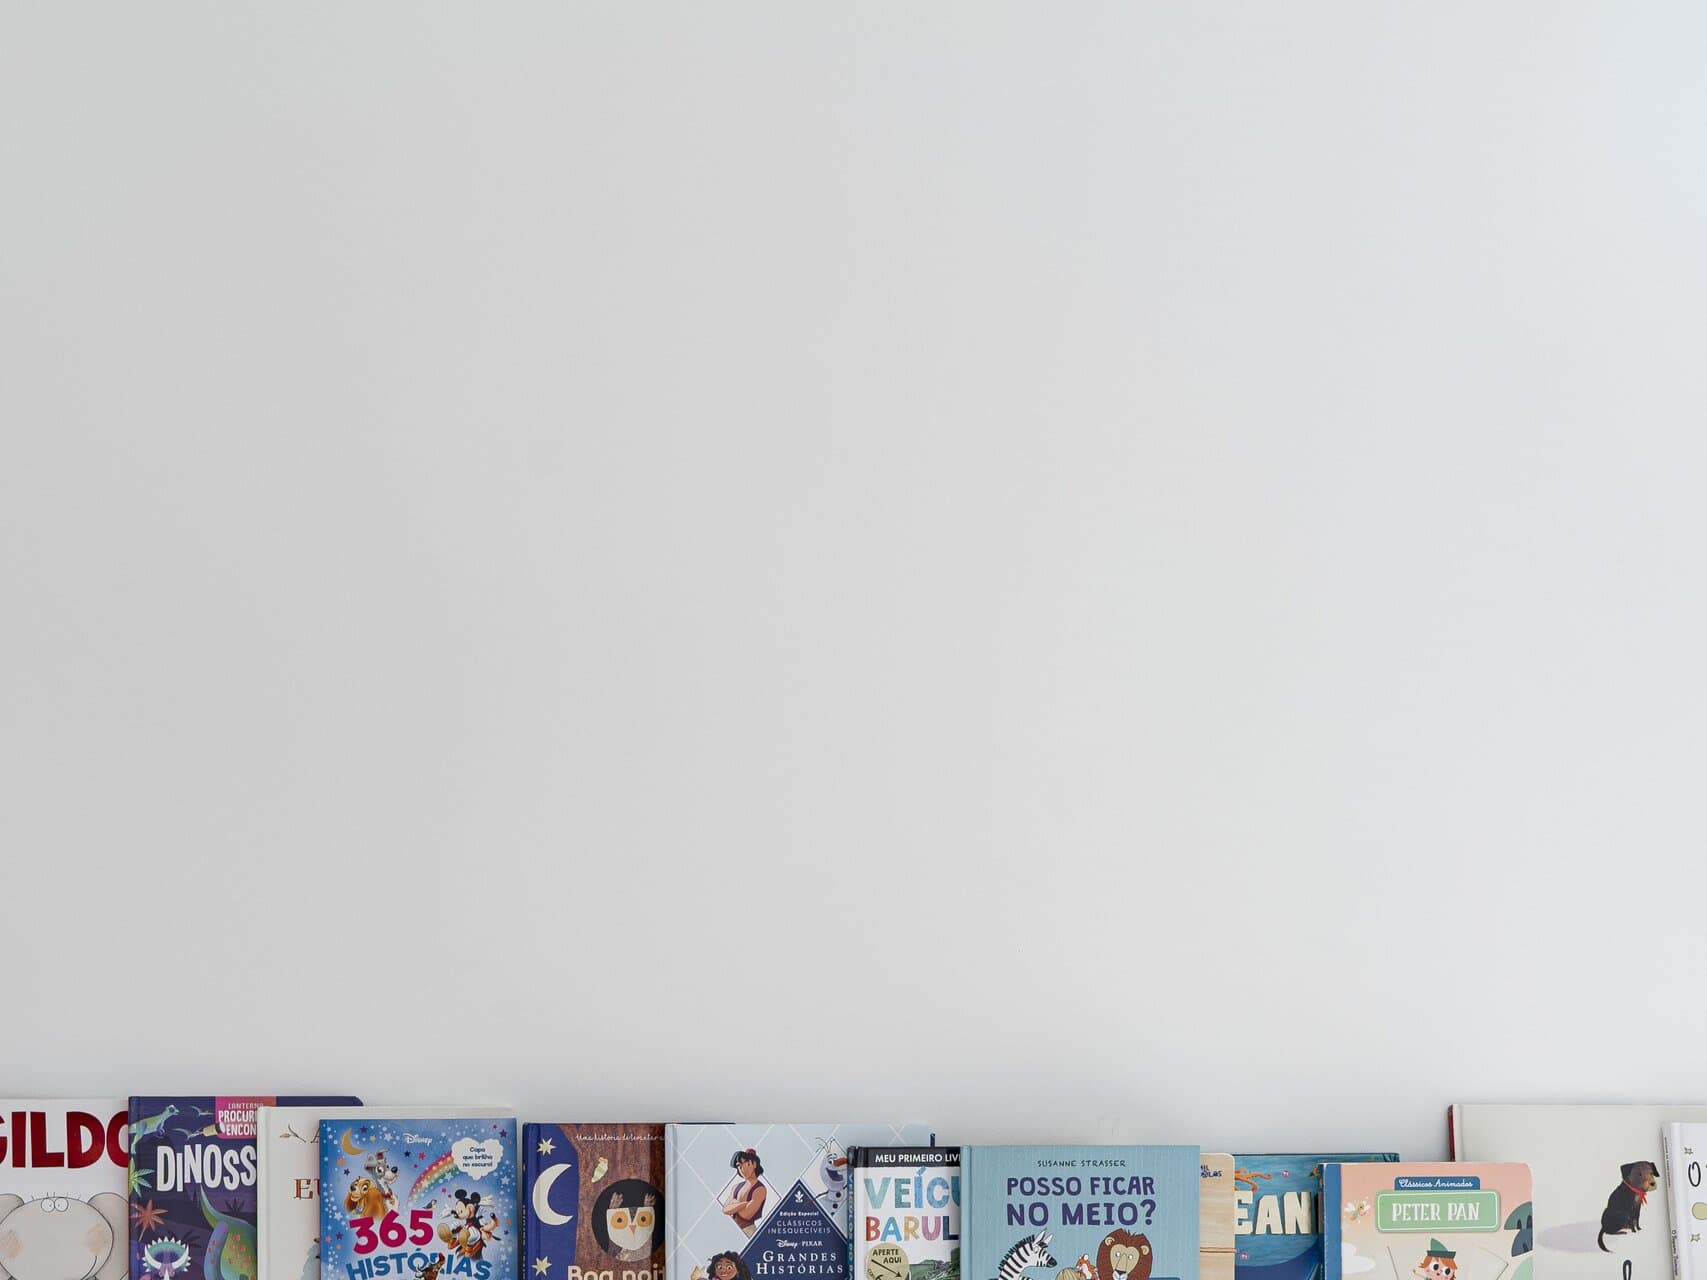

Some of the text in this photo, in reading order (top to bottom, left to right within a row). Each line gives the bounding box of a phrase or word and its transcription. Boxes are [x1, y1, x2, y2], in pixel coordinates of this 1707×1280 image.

[226, 1123, 257, 1136] ENCON
[0, 1111, 128, 1168] ILDO
[402, 1133, 433, 1147] Disney
[875, 1153, 960, 1163] MEU PRIMEIRO LIV
[1037, 1159, 1126, 1168] SUSANNE STRASSER
[1007, 1176, 1155, 1197] POSSO FICAR
[1433, 1178, 1475, 1188] Animados
[1006, 1199, 1157, 1226] NO MEIO?
[1391, 1202, 1481, 1222] PETER PAN
[776, 1219, 822, 1227] CLÁSSICOS
[865, 1215, 960, 1241] BARUL
[349, 1209, 434, 1255] 365
[775, 1239, 798, 1249] Disney
[762, 1250, 838, 1262] GRANDES
[883, 1256, 902, 1264] AQUI
[756, 1263, 844, 1275] HISTÓRIAS
